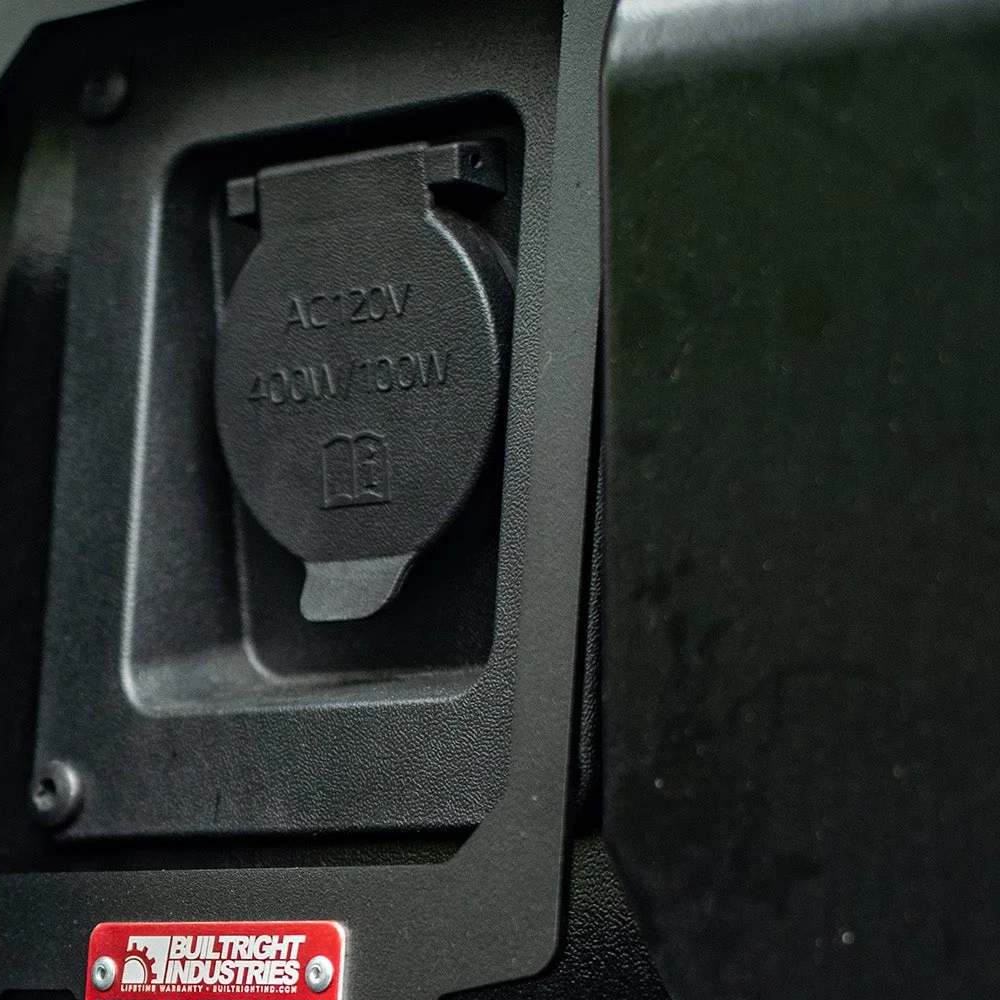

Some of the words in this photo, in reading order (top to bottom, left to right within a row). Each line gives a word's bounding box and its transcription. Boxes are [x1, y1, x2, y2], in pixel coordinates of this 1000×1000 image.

[170, 935, 306, 960] BUILTRIGHT
[164, 960, 300, 985] INDUSTRIES
[120, 984, 156, 992] LIFETIME
[159, 984, 203, 993] WARRANTY
